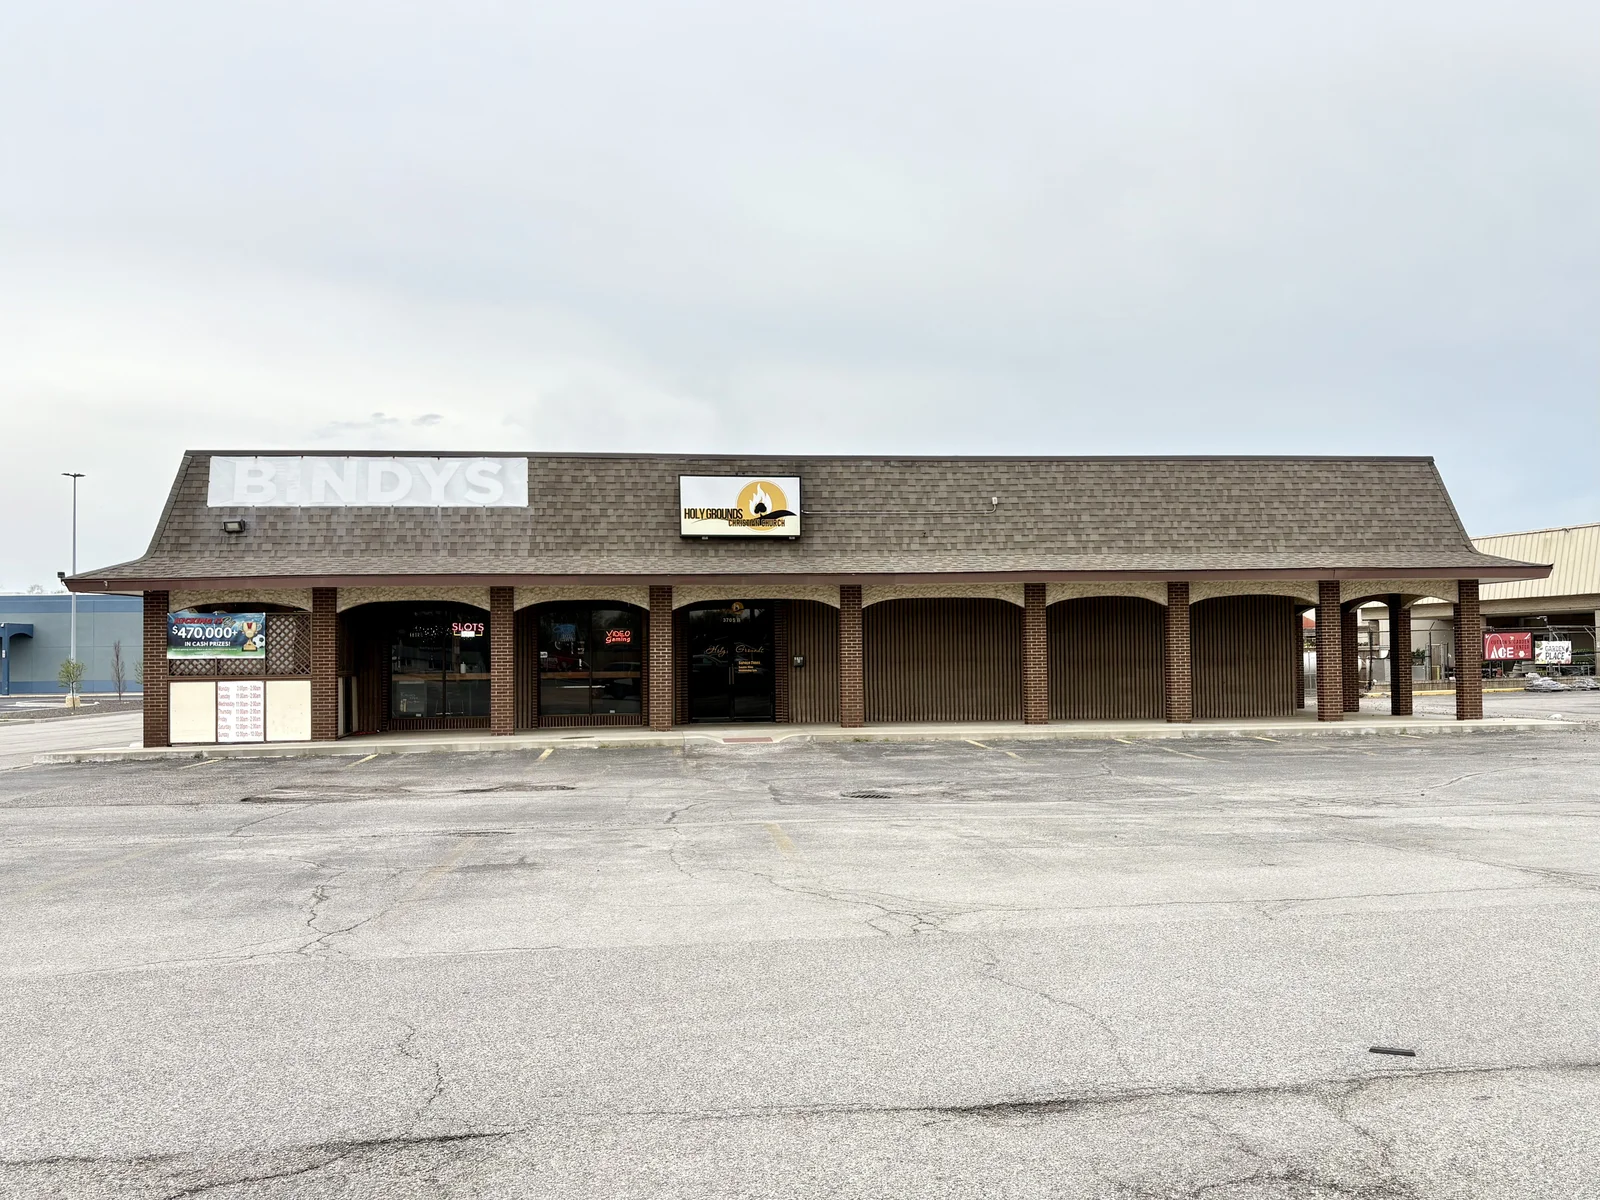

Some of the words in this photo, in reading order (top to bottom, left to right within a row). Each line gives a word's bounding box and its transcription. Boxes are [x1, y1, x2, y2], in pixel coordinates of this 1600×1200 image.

[684, 508, 705, 519] HOLY
[706, 508, 743, 519] GROUNDS
[728, 519, 760, 527] CHRISTIAN
[761, 519, 785, 527] CHURCH
[452, 622, 484, 632] SLOTS
[172, 625, 238, 640] $470,000+
[1490, 645, 1514, 659] ACE
[1545, 652, 1565, 660] PLACE
